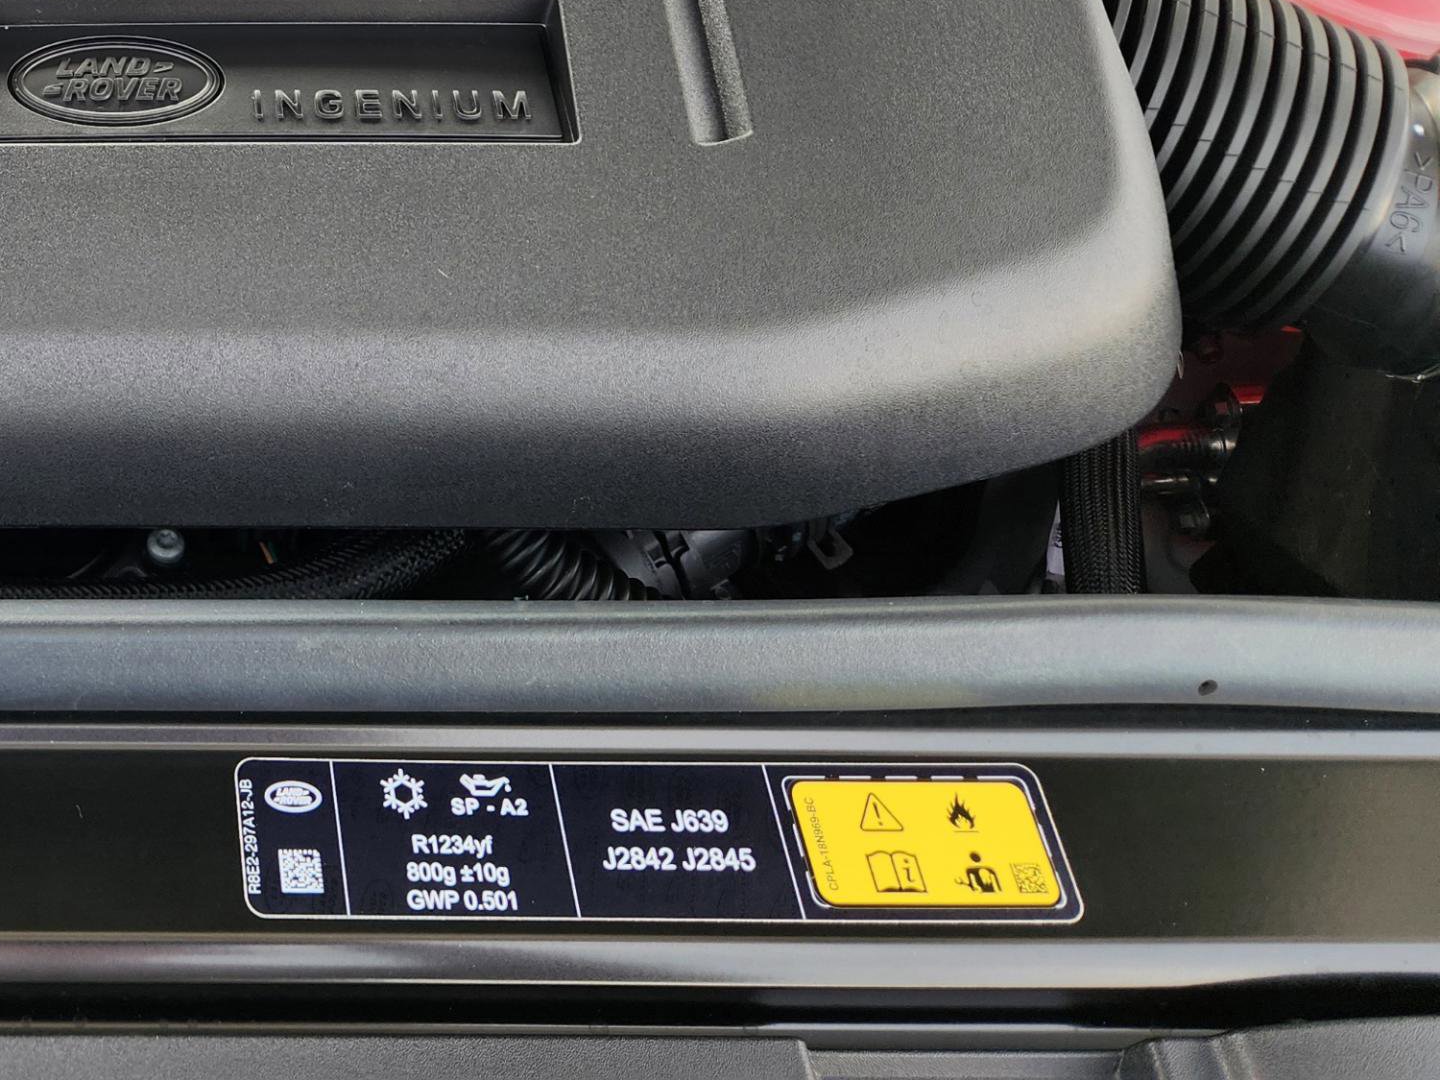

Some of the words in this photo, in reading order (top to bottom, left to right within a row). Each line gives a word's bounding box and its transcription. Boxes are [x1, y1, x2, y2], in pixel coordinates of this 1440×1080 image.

[56, 56, 151, 78] LAND
[62, 77, 183, 101] ROVER
[252, 89, 532, 120] INGENIUM
[450, 797, 480, 816] SP
[500, 798, 529, 816] A2
[610, 808, 666, 832] SAE
[670, 809, 729, 833] J639
[239, 779, 261, 894] R8E2-297A12-JB
[411, 833, 493, 859] R1234yf
[602, 846, 678, 871] J2842
[681, 847, 757, 872] J2845
[406, 861, 457, 887] 800g
[460, 862, 511, 887] ±10g
[406, 889, 460, 911] GWP
[463, 890, 518, 911] 0.501
